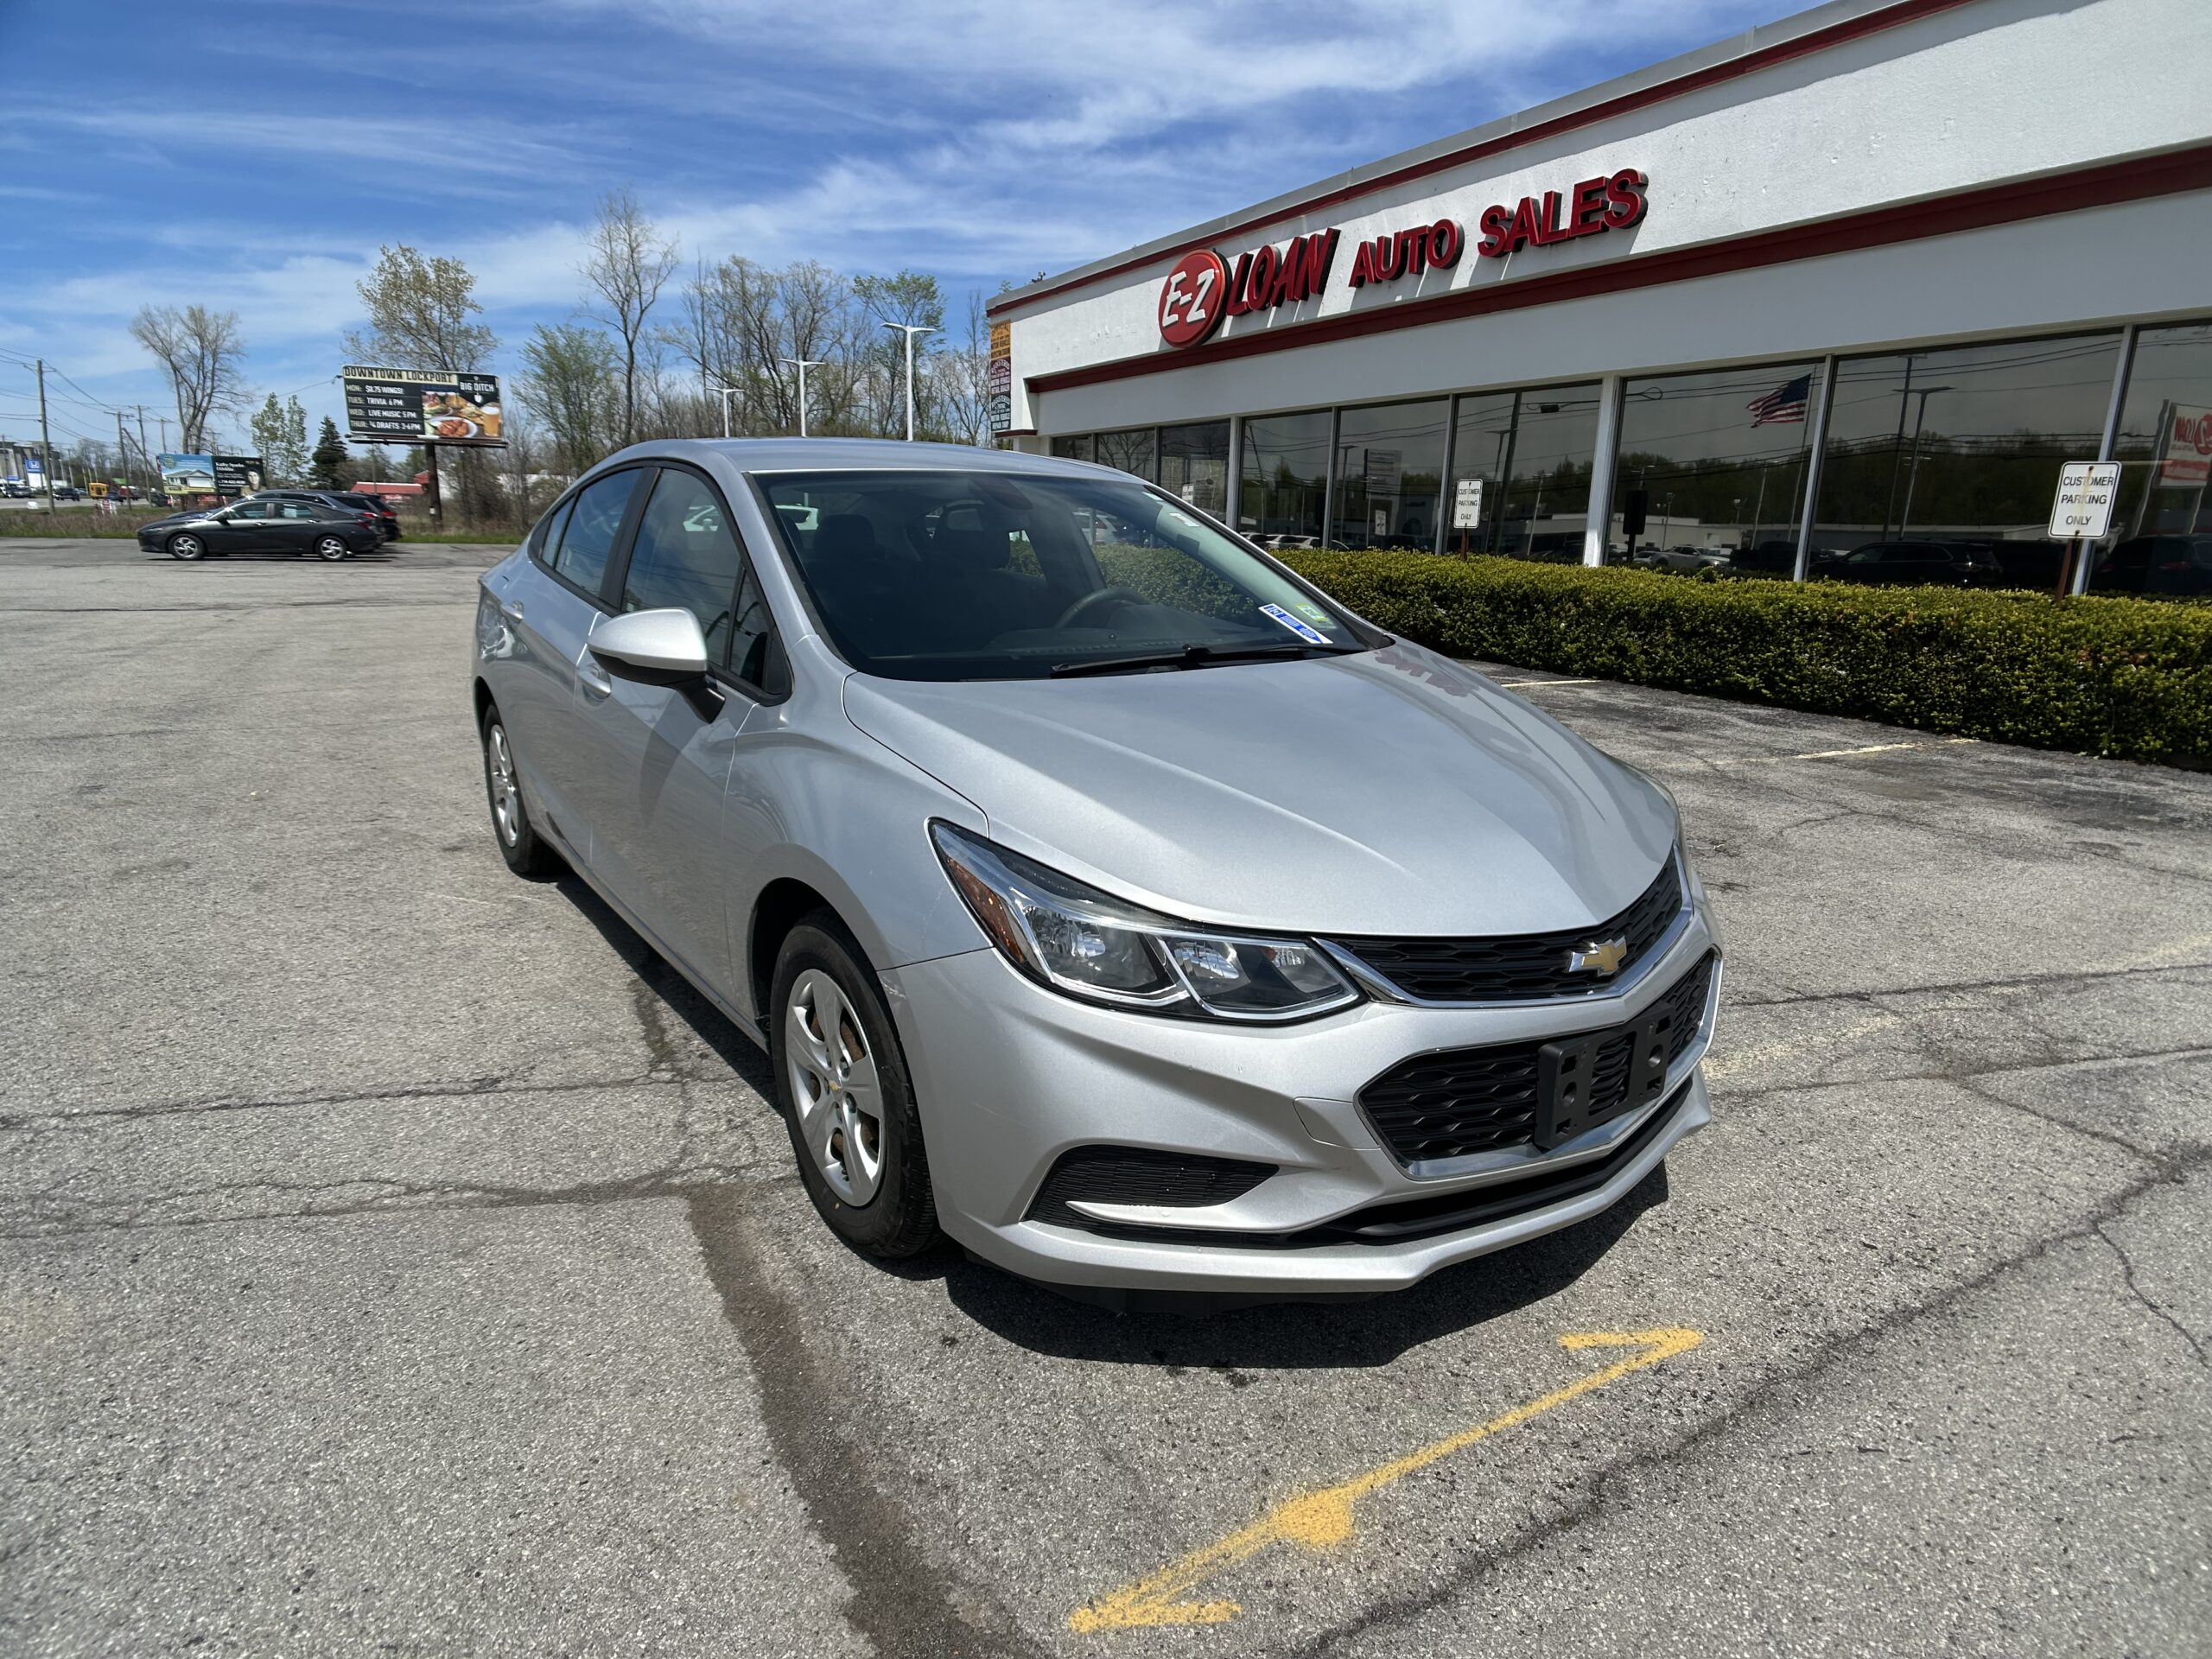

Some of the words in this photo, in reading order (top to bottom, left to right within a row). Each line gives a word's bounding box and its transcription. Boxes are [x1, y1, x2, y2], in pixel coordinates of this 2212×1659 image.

[1162, 269, 1215, 327] E-Z
[1227, 228, 1340, 316] LOAN
[1349, 219, 1464, 288] AUTO
[1478, 168, 1648, 257] SALES
[346, 366, 403, 380] DOWNTOWN
[406, 372, 453, 383] LOCKPORT
[460, 382, 473, 391] BIG
[474, 383, 494, 392] DITCH
[2063, 476, 2113, 486] CUSTOMER
[2061, 494, 2107, 504] PARKING
[2066, 515, 2092, 525] ONLY
